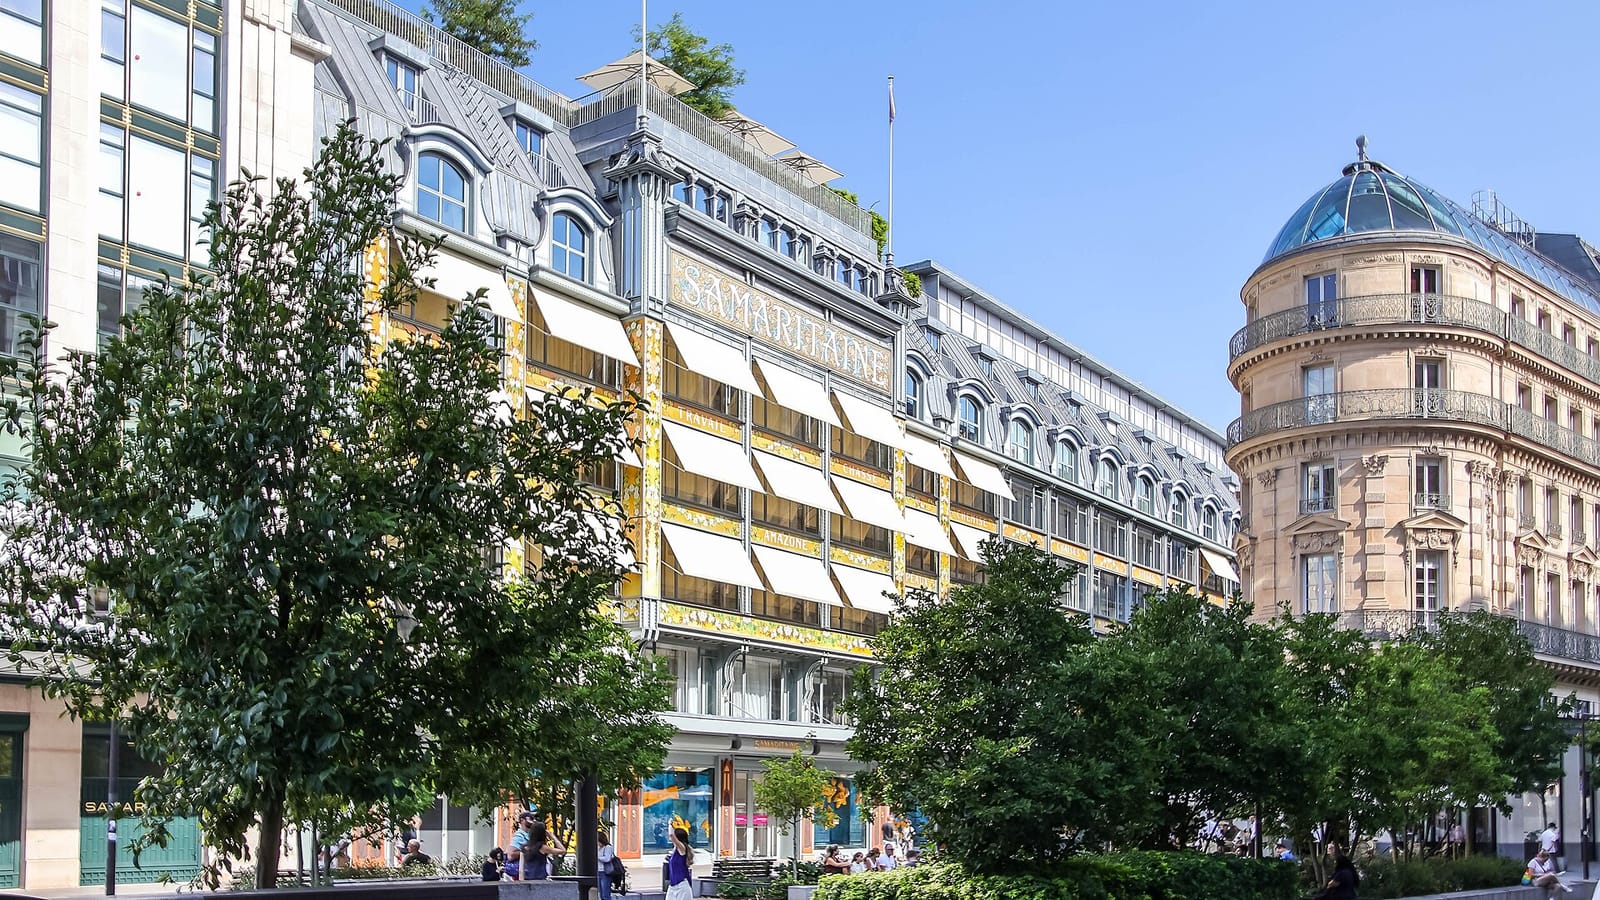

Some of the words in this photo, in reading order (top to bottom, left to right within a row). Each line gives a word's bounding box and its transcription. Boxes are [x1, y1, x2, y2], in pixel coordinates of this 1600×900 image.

[683, 264, 888, 386] SAMARITAINE
[678, 406, 726, 434] TRAVAIL
[843, 464, 878, 484] CHASSE
[764, 532, 808, 551] AMAZONE
